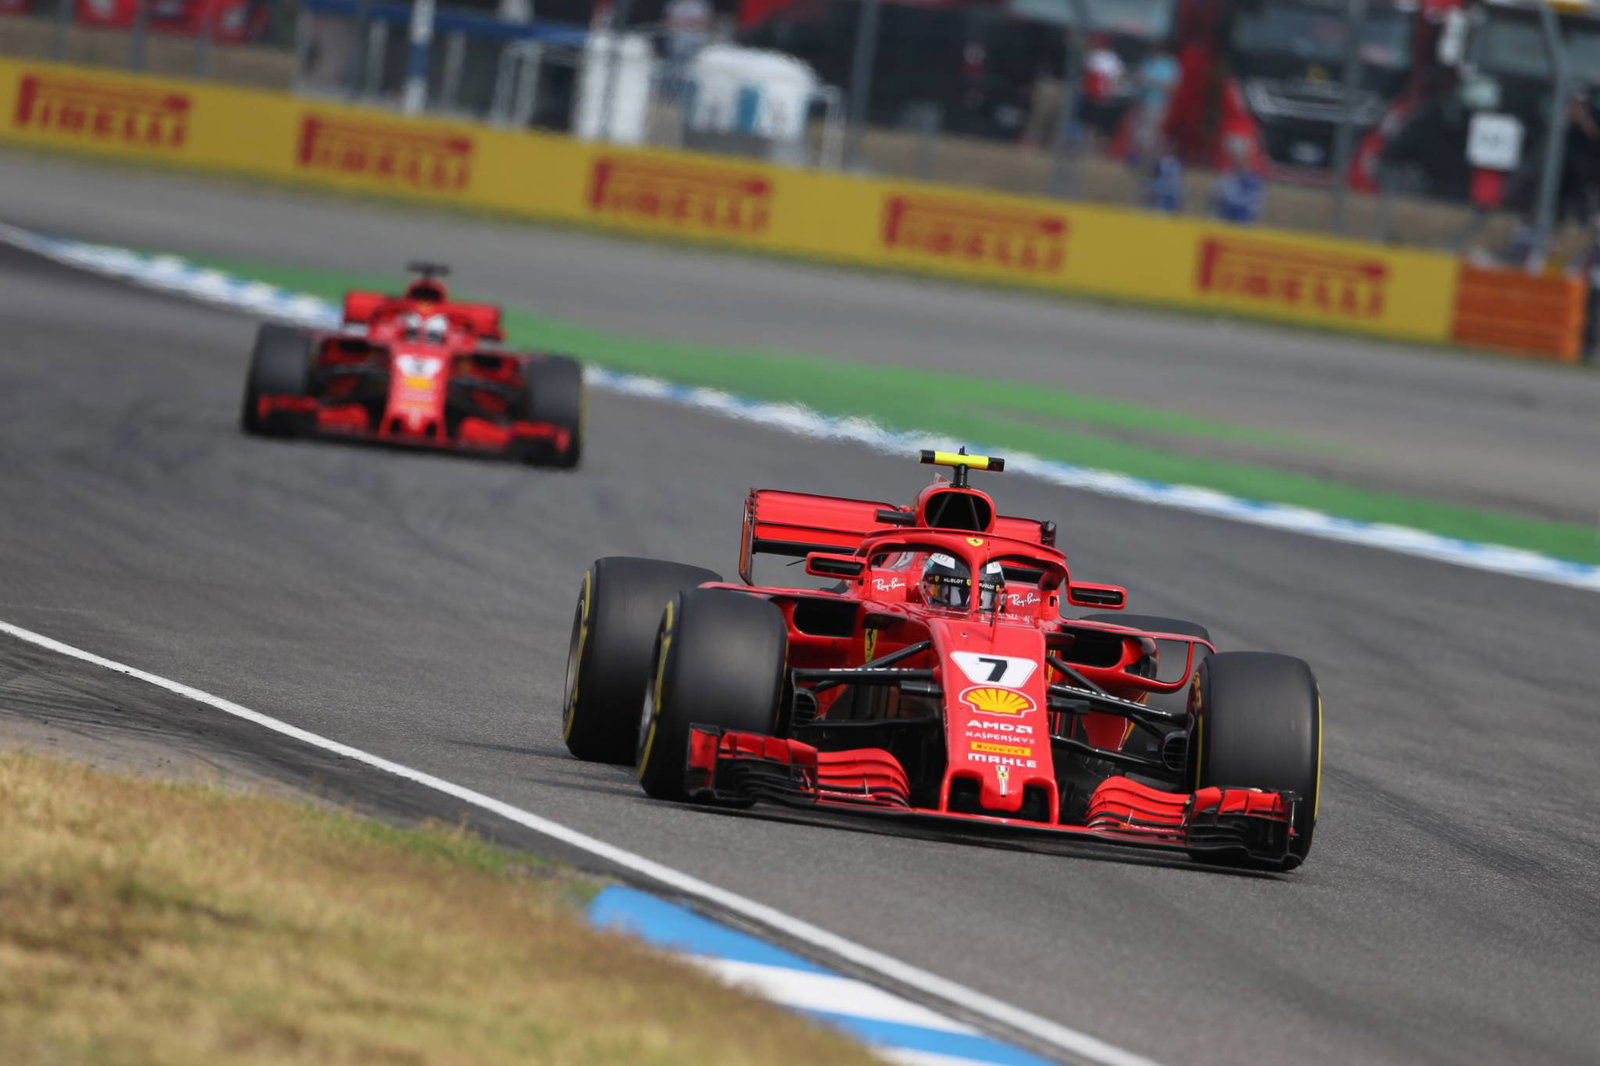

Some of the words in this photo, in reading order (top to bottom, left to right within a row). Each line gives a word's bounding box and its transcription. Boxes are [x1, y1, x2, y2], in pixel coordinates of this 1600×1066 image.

[17, 75, 189, 147] PIRELLI
[978, 657, 1008, 683] 7
[967, 752, 1037, 768] MAHLE
